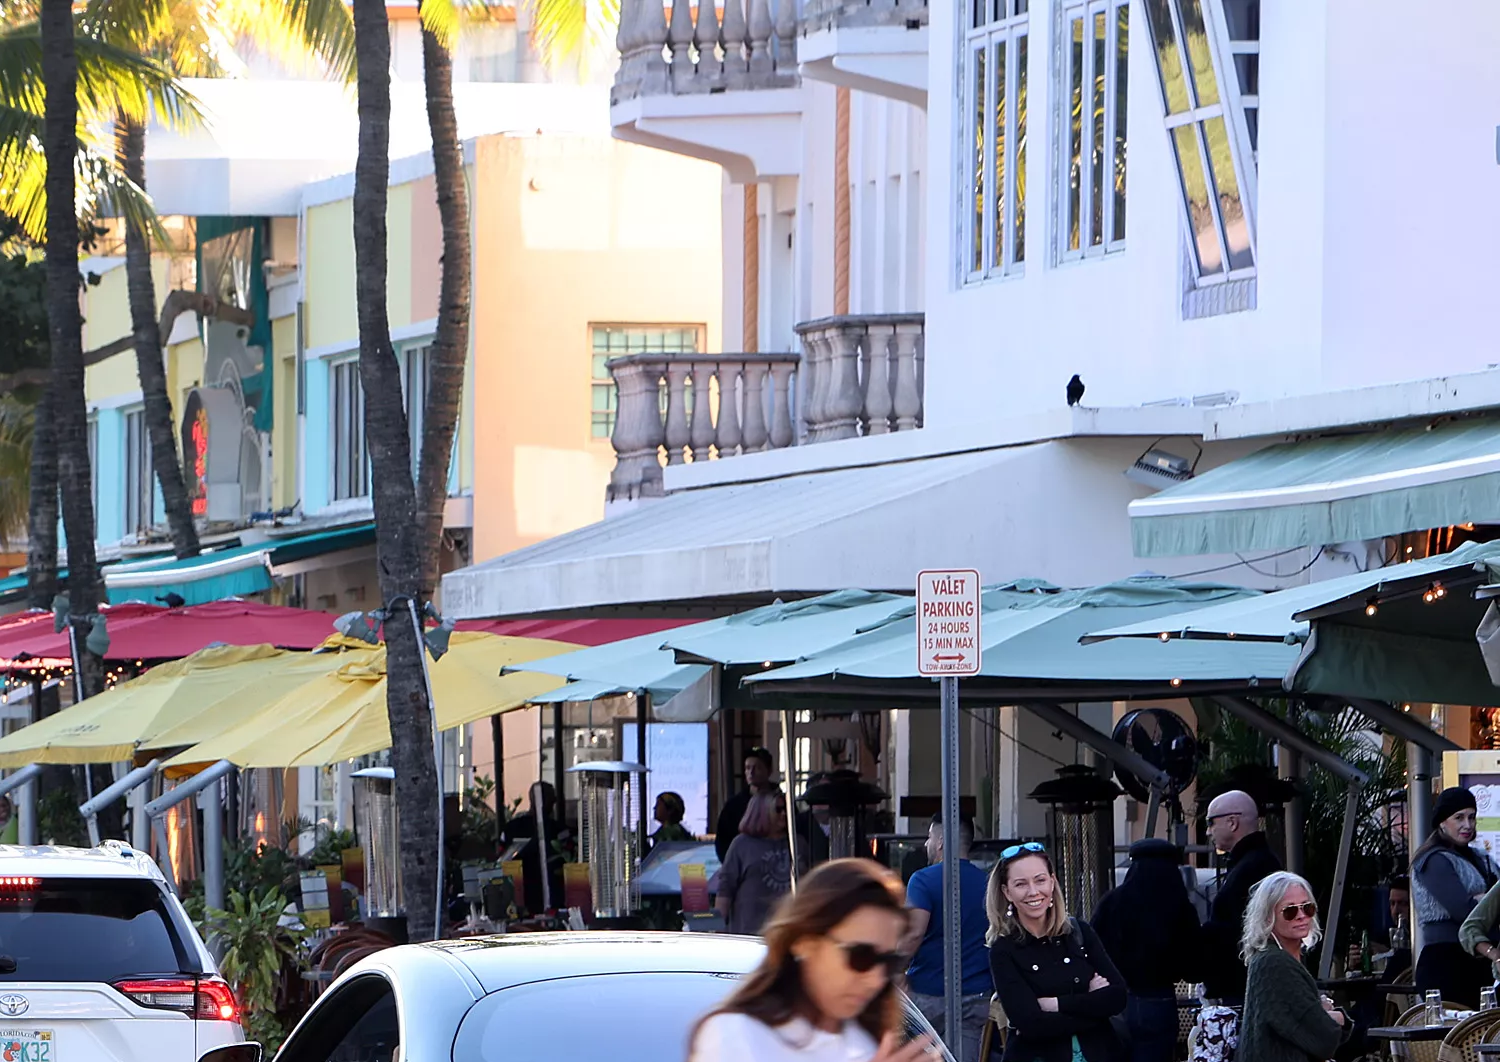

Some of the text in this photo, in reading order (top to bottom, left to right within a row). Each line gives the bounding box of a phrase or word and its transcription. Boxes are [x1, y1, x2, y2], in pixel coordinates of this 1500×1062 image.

[932, 579, 966, 595] VALET
[923, 601, 974, 617] PARKING
[928, 622, 970, 634] 24 HOURS
[924, 637, 974, 649] 15 MIN MAX
[21, 1041, 50, 1062] K32
